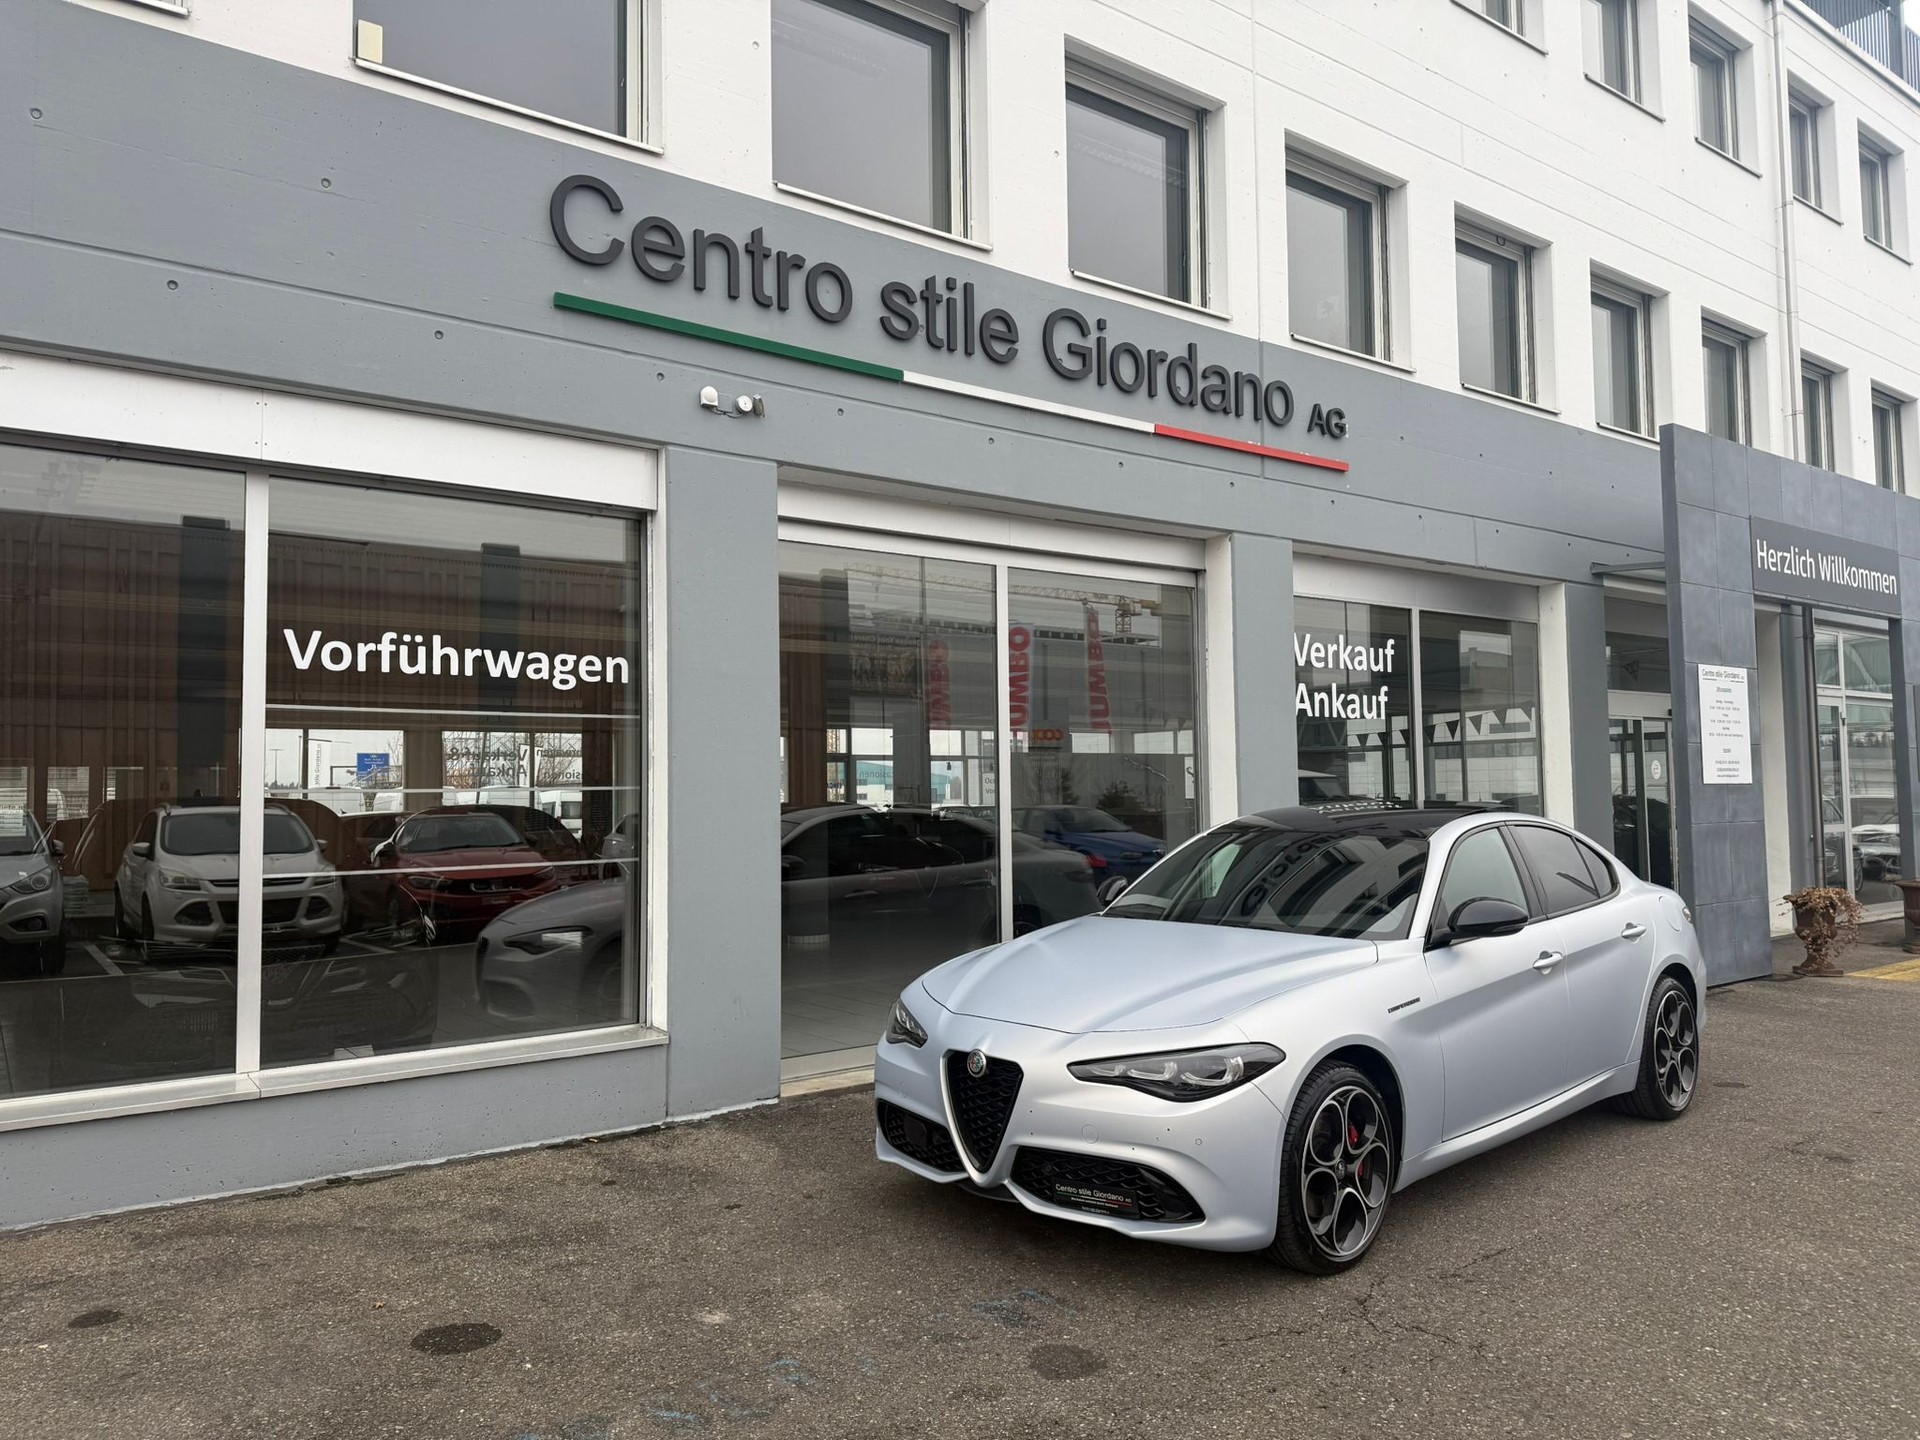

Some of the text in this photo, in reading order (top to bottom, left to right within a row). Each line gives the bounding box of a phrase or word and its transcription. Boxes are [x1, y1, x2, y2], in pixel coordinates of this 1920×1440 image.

[550, 174, 1348, 439] Centro stile Giordano AG
[1756, 539, 1898, 595] Herzlich Willkommen
[283, 628, 629, 690] Vorführwagen
[1009, 626, 1031, 728] UMBO
[1294, 632, 1395, 673] Verkauf
[1295, 683, 1389, 720] Ankauf
[1055, 1183, 1078, 1194] Centro
[1078, 1188, 1092, 1196] stile
[1093, 1189, 1124, 1202] Giordano
